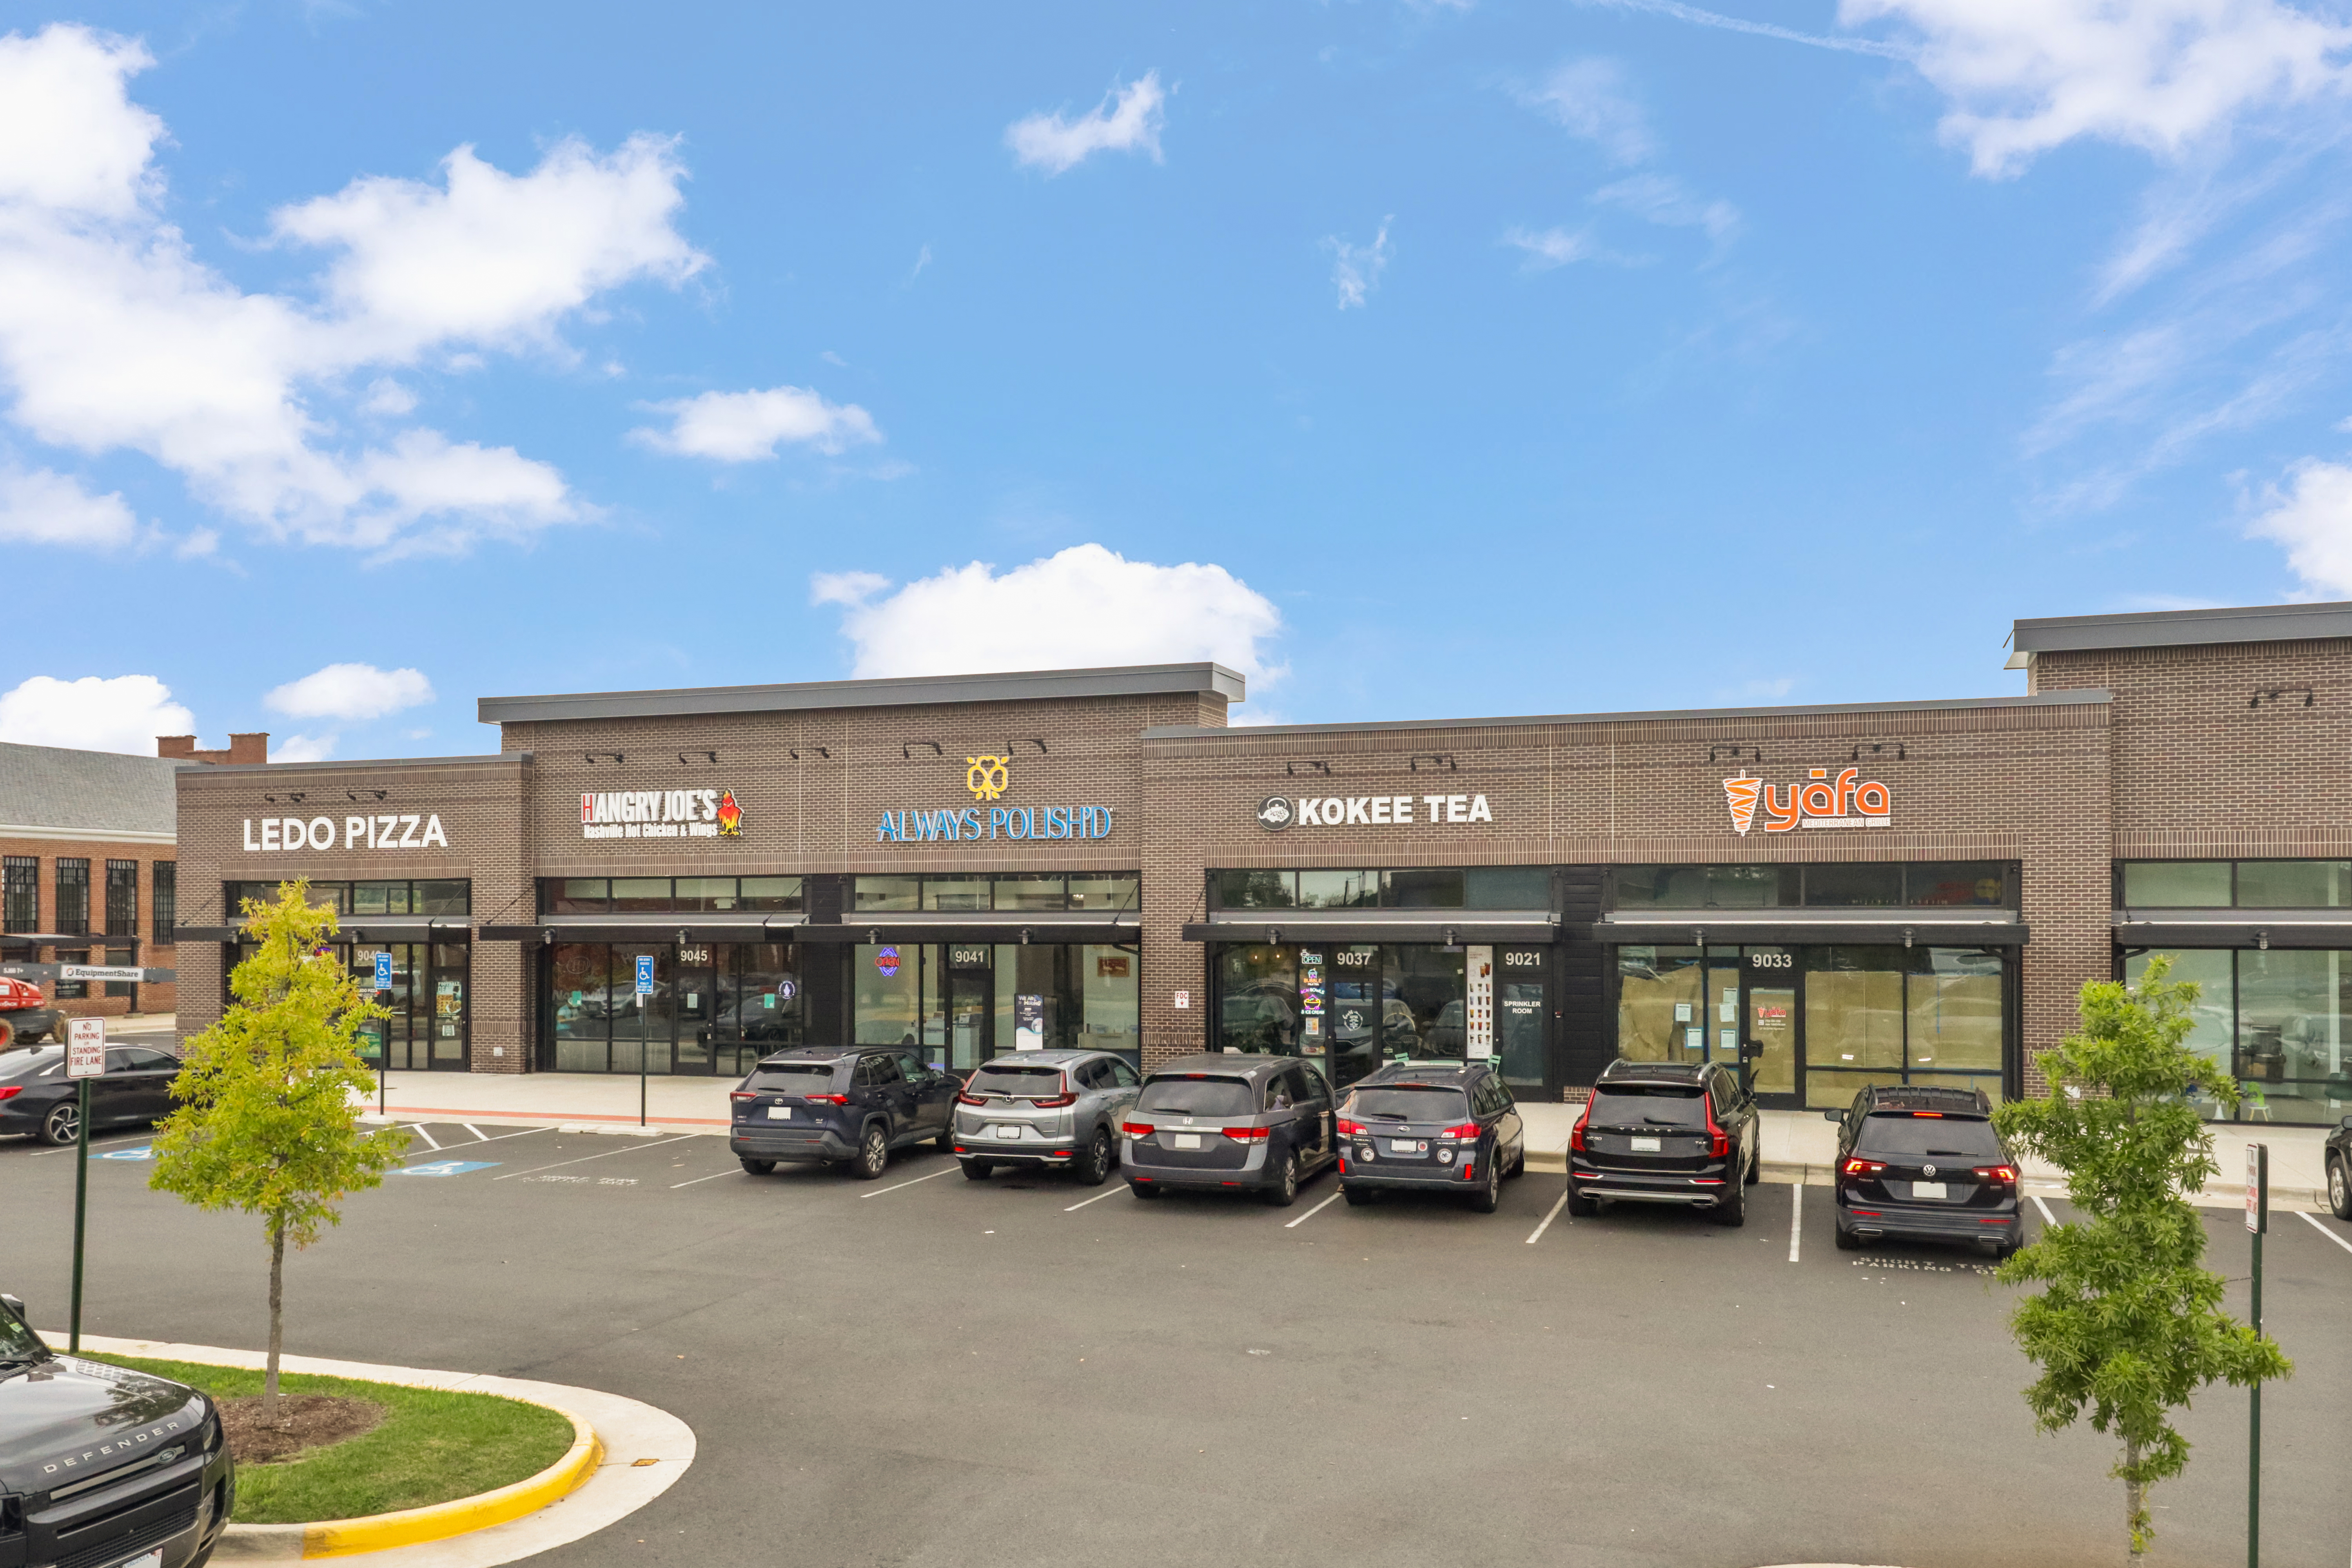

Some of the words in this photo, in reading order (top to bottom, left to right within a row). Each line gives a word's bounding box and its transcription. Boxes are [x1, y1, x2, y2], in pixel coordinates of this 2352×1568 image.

[581, 791, 663, 822] HANGRY
[662, 789, 718, 822] JOE'S
[1299, 797, 1413, 825] KOKEE
[1424, 795, 1492, 822] TEA
[876, 809, 982, 842] ALWAYS
[1802, 818, 1865, 828] MEDITERRANEAN
[1866, 817, 1891, 827] GRILLE
[243, 817, 336, 851] LEDO
[345, 814, 448, 849] PIZZA
[584, 824, 623, 838] Nashville
[626, 824, 641, 837] Hot
[642, 823, 678, 837] Chicken
[680, 824, 687, 837] &
[689, 822, 718, 838] Wings
[358, 950, 381, 960] 904
[681, 950, 708, 961] 9045
[955, 951, 983, 962] 9041
[1337, 953, 1371, 965] 9037
[1506, 953, 1540, 965] 9021
[1753, 954, 1792, 967] 9033
[875, 957, 900, 966] OPEN
[75, 969, 138, 978] EquipmentShare
[70, 1057, 83, 1066] FIRE
[86, 1056, 102, 1065] LANE
[1853, 1261, 1951, 1272] PARKING
[1860, 1257, 1935, 1266] SHORT
[44, 1422, 179, 1473] DEFENDER
